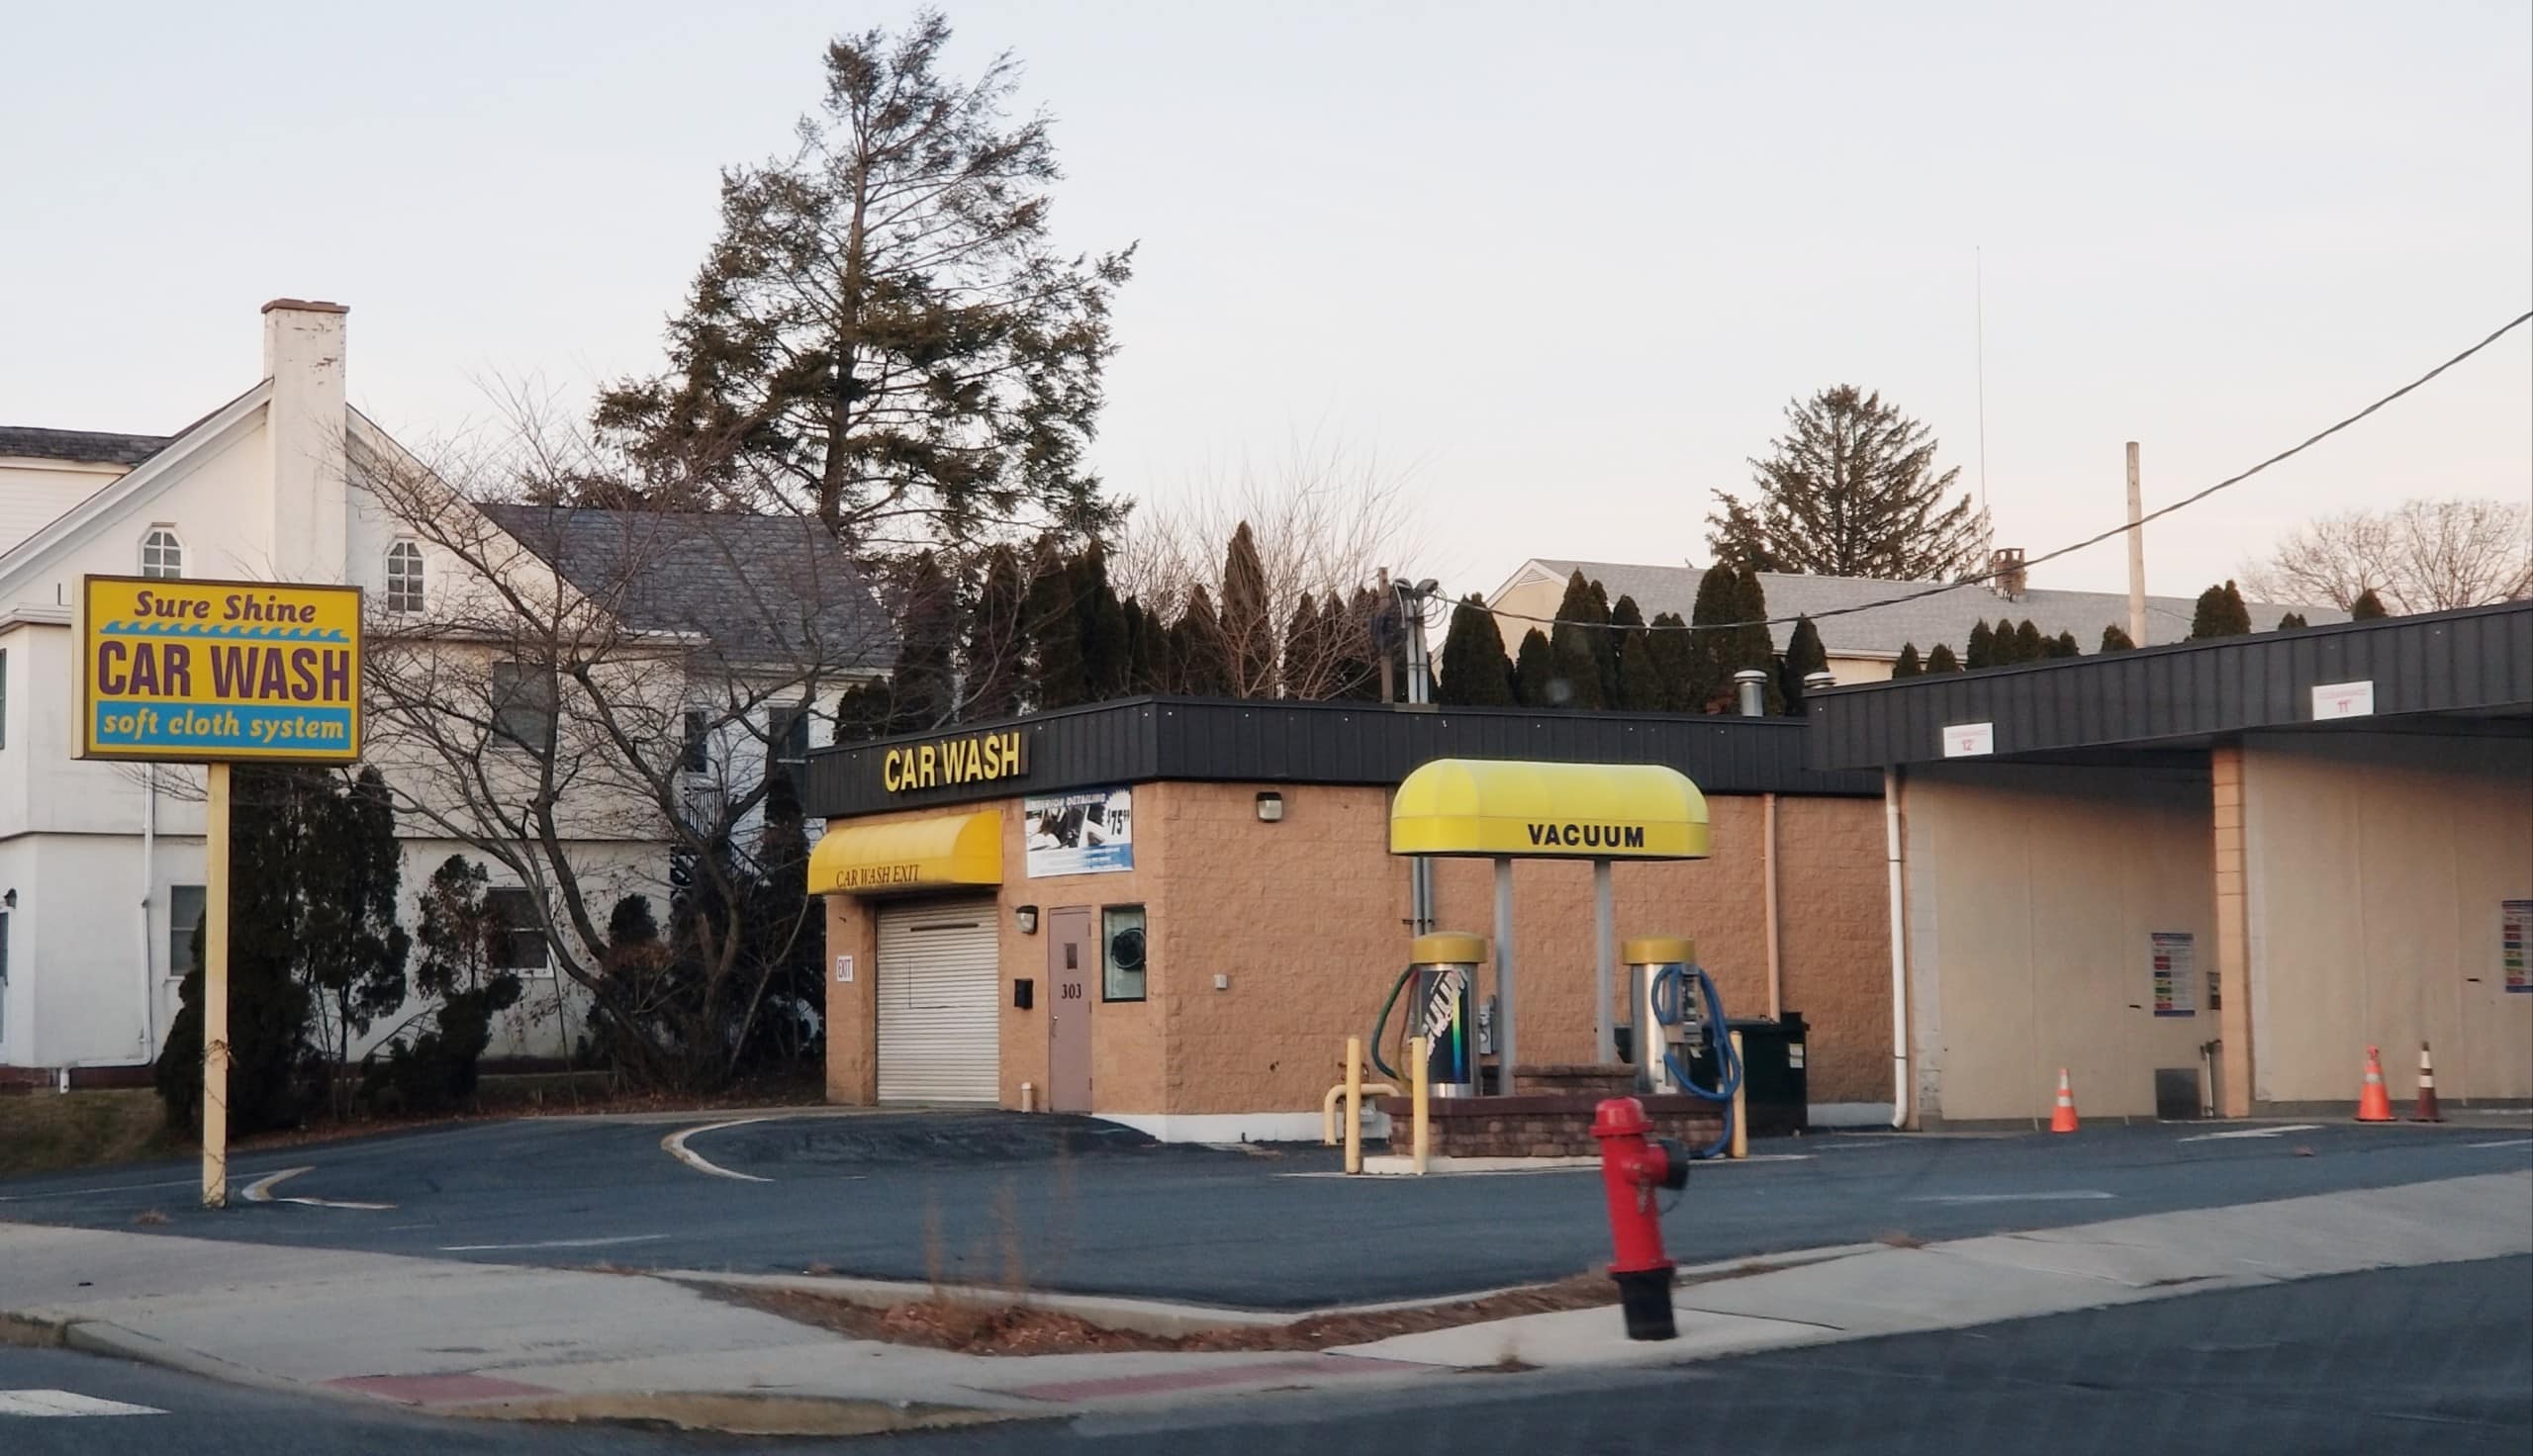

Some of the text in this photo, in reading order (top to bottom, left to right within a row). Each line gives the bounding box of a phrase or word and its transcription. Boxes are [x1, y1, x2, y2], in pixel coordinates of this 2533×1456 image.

[135, 591, 317, 623] Sure Shine
[99, 640, 350, 701] CAR WASH
[103, 708, 343, 743] soft cloth system
[885, 732, 1020, 792] CAR WASH
[1528, 824, 1644, 848] VACUUM
[836, 864, 918, 887] CAR WASH EXIT
[838, 958, 851, 978] EXIT
[1061, 983, 1082, 999] 303
